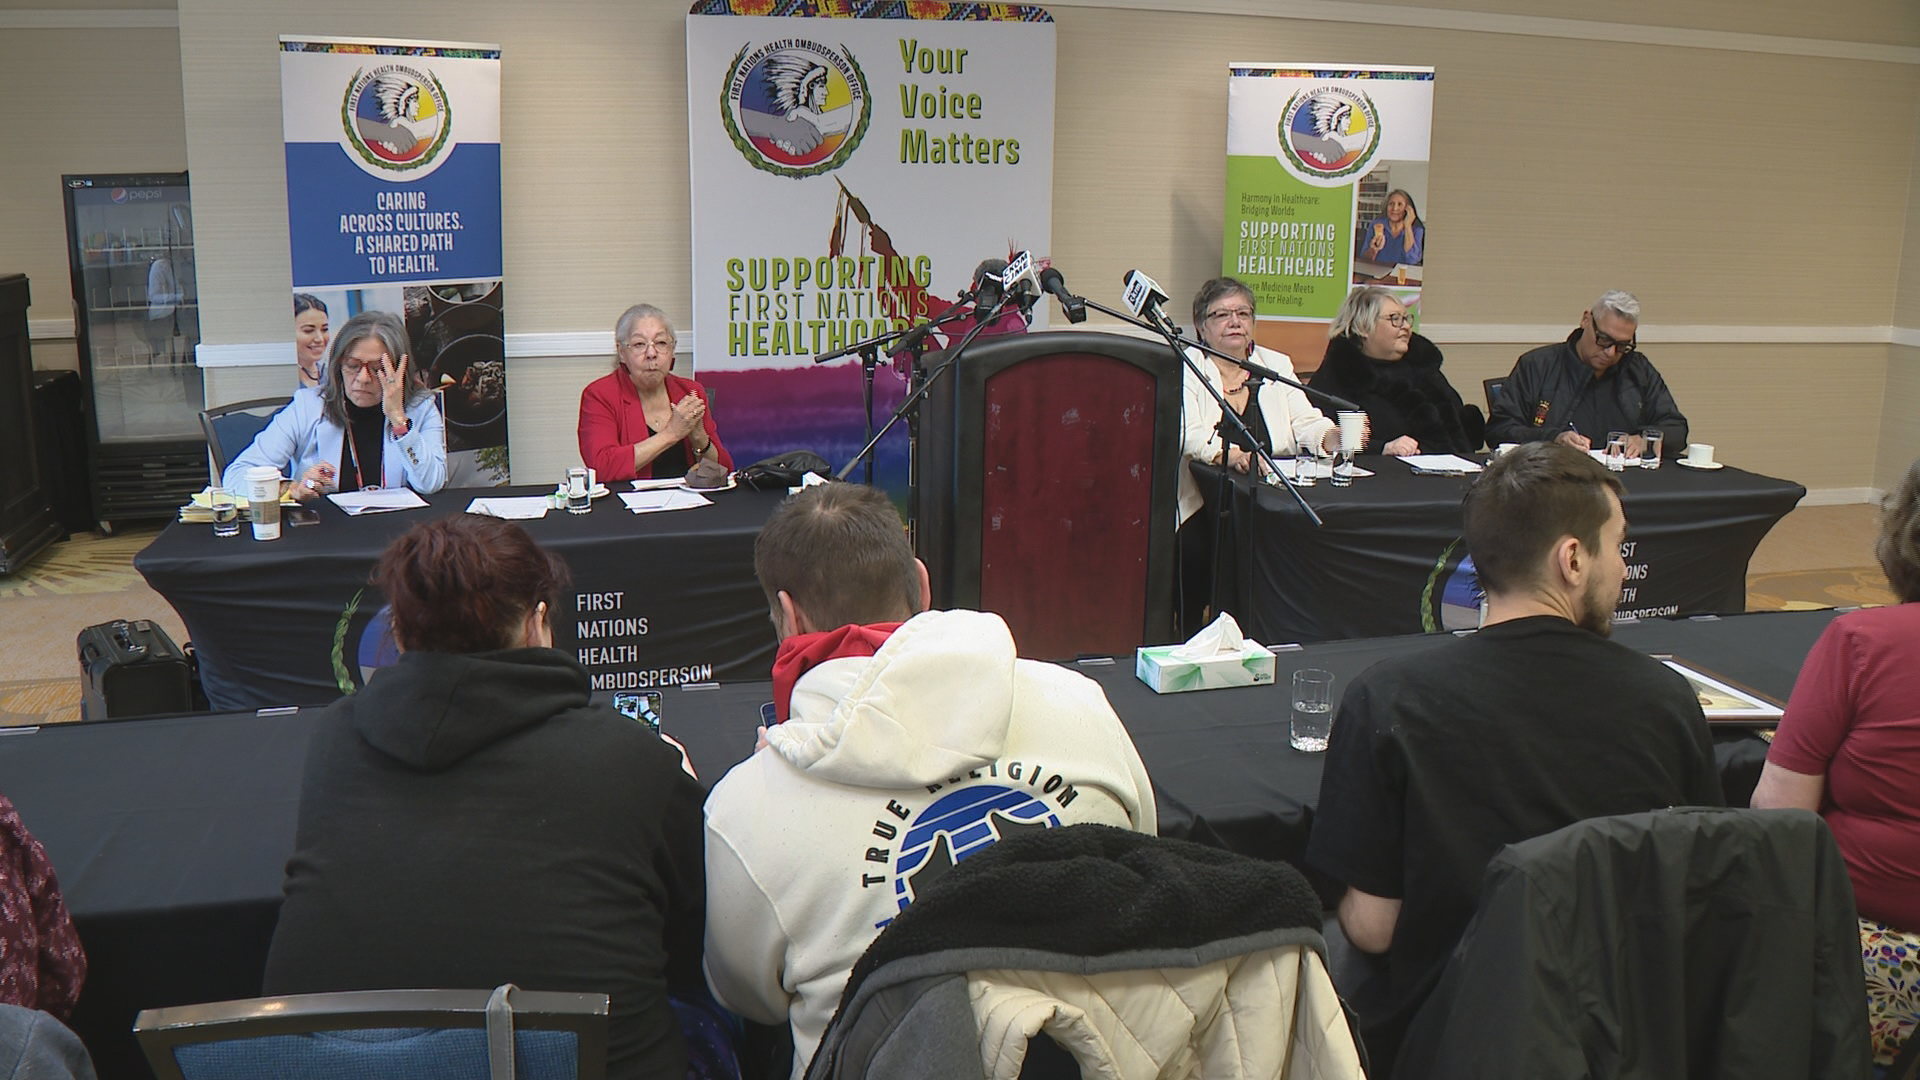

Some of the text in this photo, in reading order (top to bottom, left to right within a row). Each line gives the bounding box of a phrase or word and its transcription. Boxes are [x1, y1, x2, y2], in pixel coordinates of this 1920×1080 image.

[899, 38, 968, 74] Your
[731, 38, 862, 101] FIRST NATIONS HEALTH OMBUDSPERSON OFFICE
[349, 64, 444, 112] FIRST NATIONS HEALTH OMBUDSPERSON OFFICE
[899, 84, 982, 119] Voice
[1285, 86, 1375, 128] FIRST NATIONS HEALTH OMBUDSPERSON OFFICE
[900, 128, 1020, 164] Matters
[129, 189, 162, 201] pepsi
[376, 191, 427, 211] CARING
[1241, 192, 1272, 205] Harmony
[1281, 194, 1320, 205] Healthcare:
[1241, 204, 1295, 217] Bridging Worlds
[340, 211, 464, 233] ACROSS CULTURES.
[1240, 220, 1335, 241] SUPPORTING
[355, 232, 453, 254] A SHARED PATH
[1239, 239, 1335, 257] FIRST NATIONS
[369, 254, 439, 275] TO HEALTH.
[726, 255, 932, 291] SUPPORTING
[1004, 252, 1028, 277] CKOM
[1004, 260, 1029, 285] CJME
[1238, 255, 1335, 277] HEALTHCARE
[1261, 281, 1292, 293] Medicine
[1293, 282, 1315, 294] Meets
[1266, 293, 1275, 304] for
[729, 289, 930, 320] FIRST NATIONS
[577, 592, 624, 612] FIRST
[577, 617, 649, 639] NATIONS
[578, 644, 638, 666] HEALTH
[590, 663, 713, 691] MBUDSPERSON
[862, 761, 1079, 887] TRUE IGION
